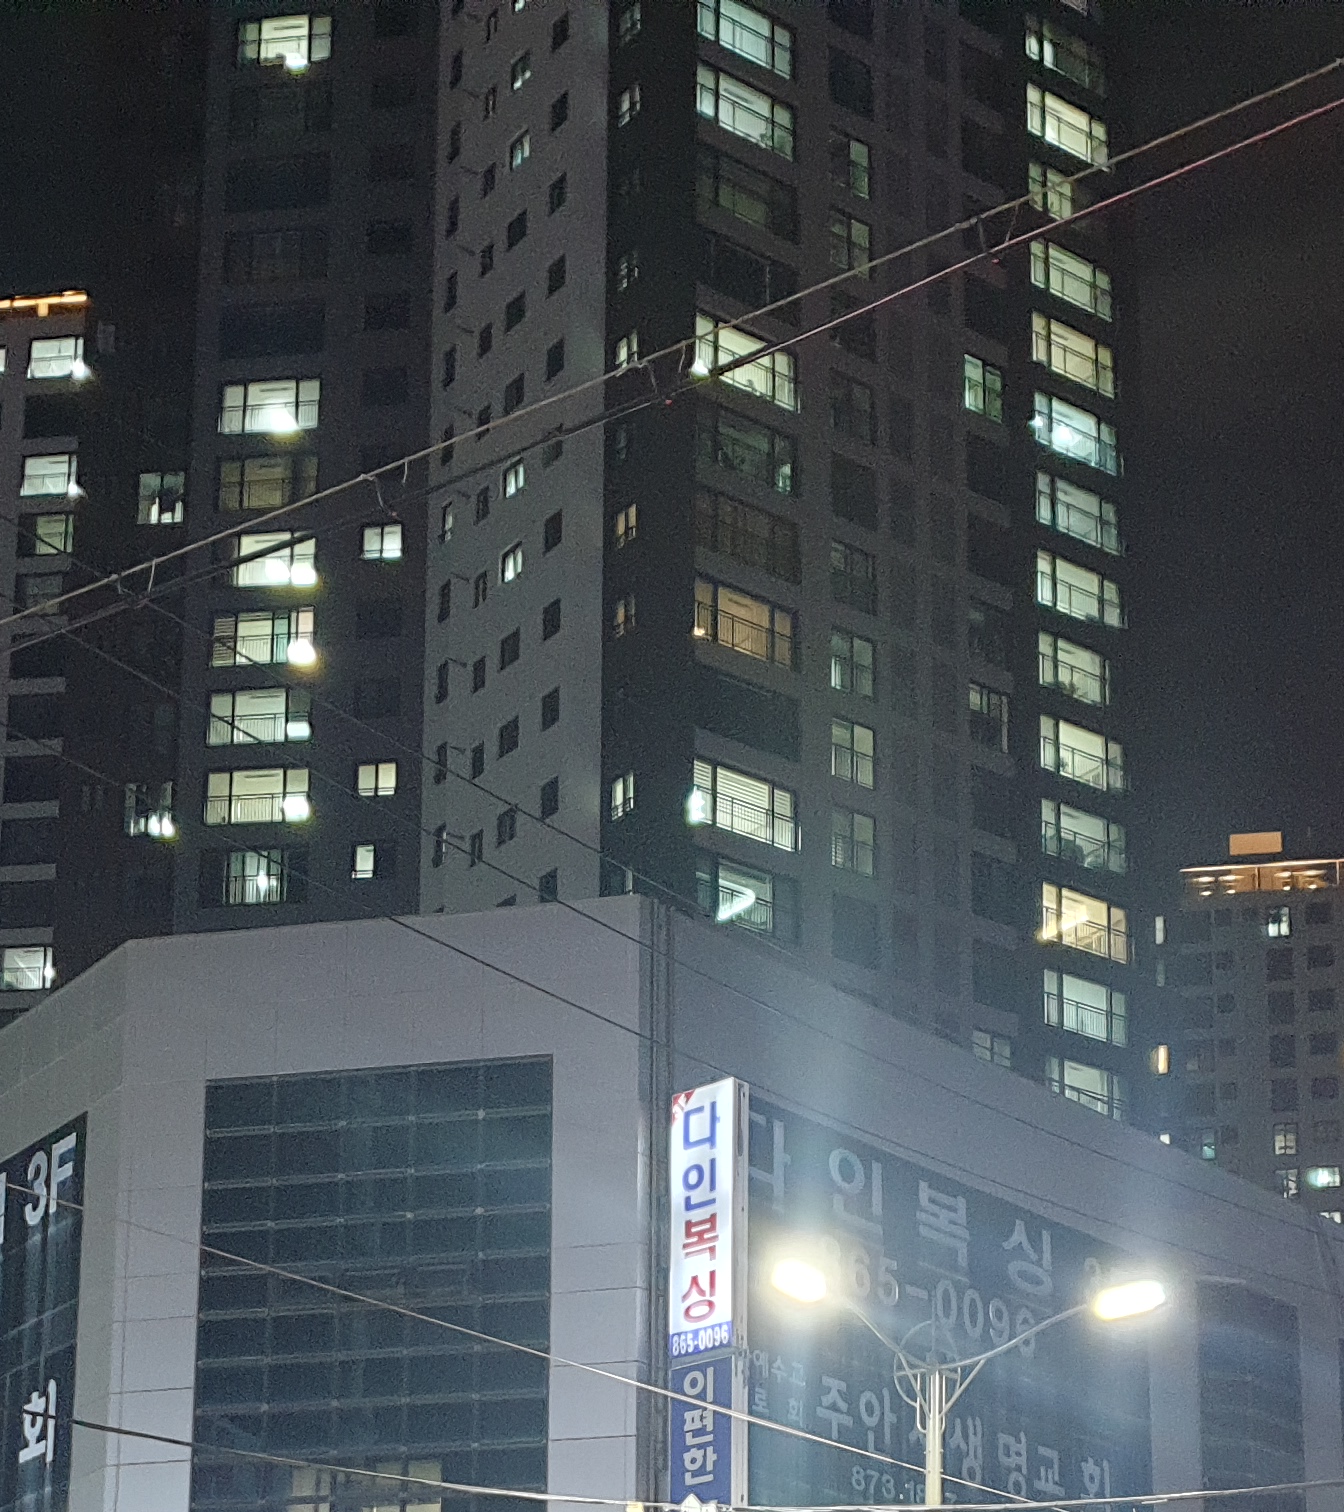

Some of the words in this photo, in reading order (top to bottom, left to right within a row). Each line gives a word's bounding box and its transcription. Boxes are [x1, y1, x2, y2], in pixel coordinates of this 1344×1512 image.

[24, 1132, 77, 1228] 3F
[681, 1100, 721, 1324] 다인복싱
[671, 1323, 730, 1356] 865-0096
